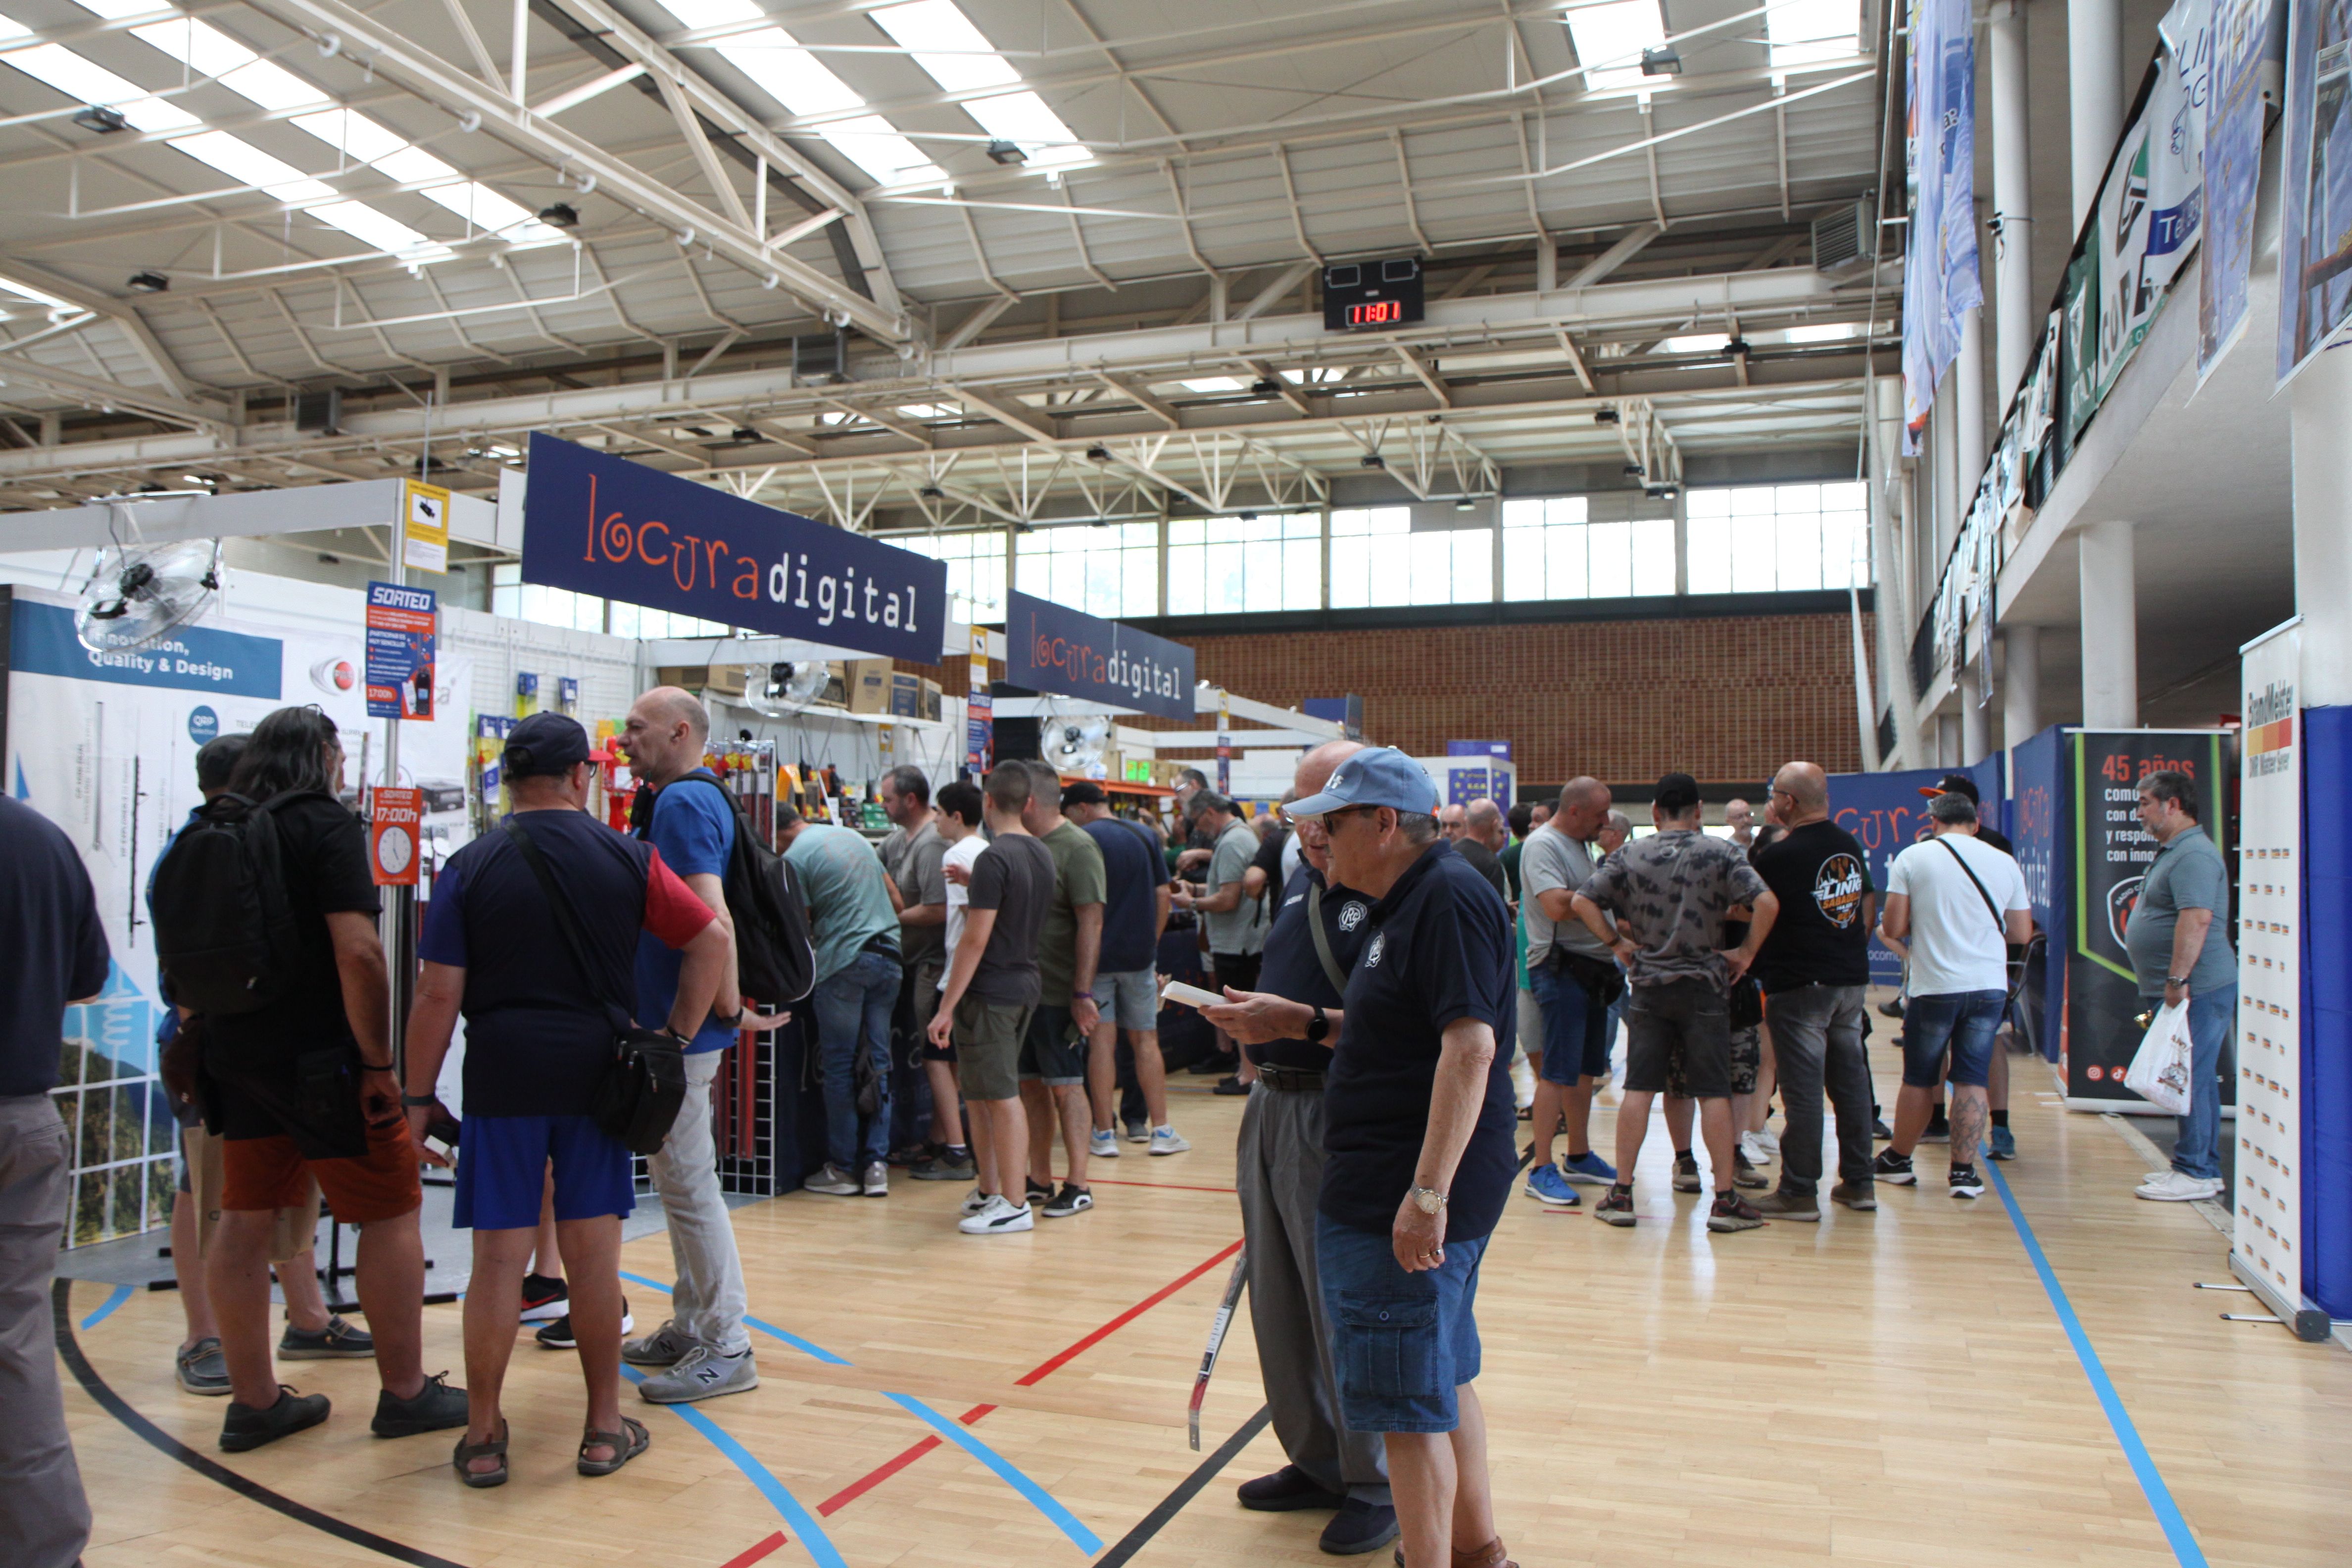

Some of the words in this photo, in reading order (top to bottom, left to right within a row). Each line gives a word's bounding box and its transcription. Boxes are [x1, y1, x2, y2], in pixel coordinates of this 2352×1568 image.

[1354, 301, 1400, 324] 11:01
[88, 650, 154, 673] Quality
[158, 657, 171, 672] &
[176, 659, 233, 681] Design
[2102, 754, 2130, 782] 45
[2105, 787, 2140, 802] comu
[376, 807, 418, 823] 17:00h
[2106, 809, 2126, 822] con
[2106, 830, 2113, 845] y
[2106, 849, 2127, 862] con
